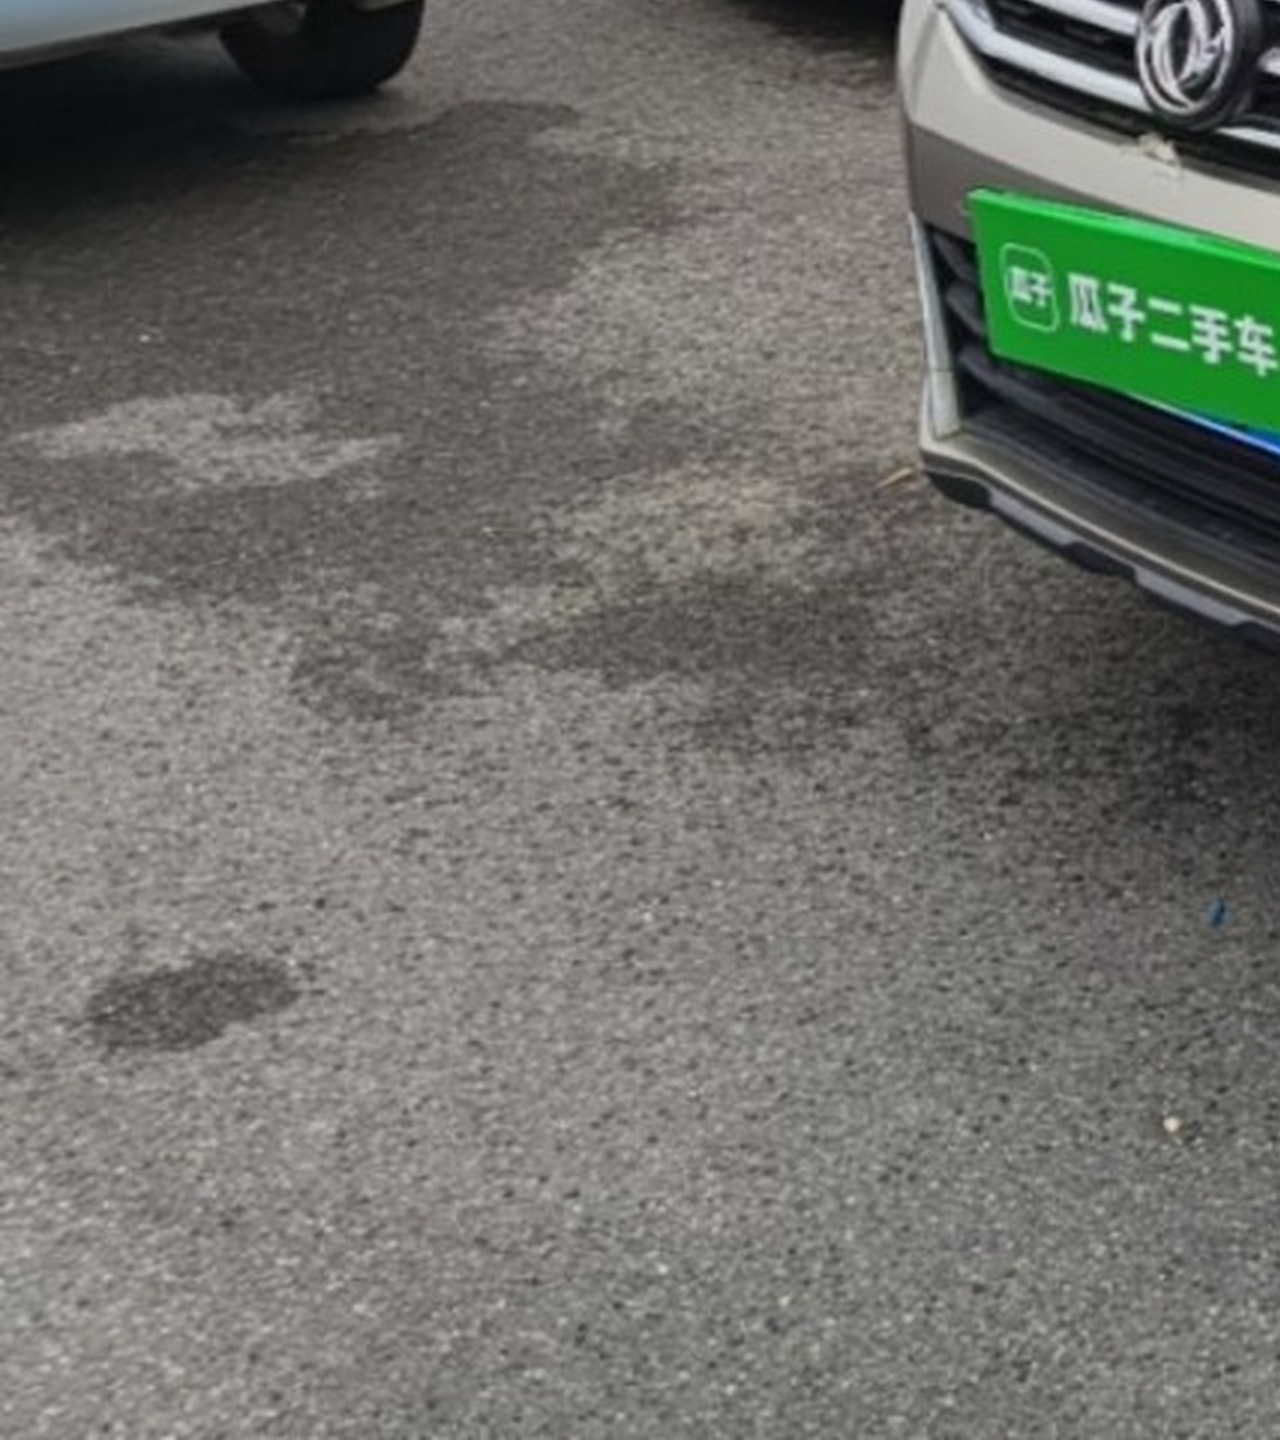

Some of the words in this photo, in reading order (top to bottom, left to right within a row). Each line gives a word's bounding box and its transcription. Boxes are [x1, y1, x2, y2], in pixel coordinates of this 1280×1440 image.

[1067, 273, 1280, 378] 瓜子二手车
